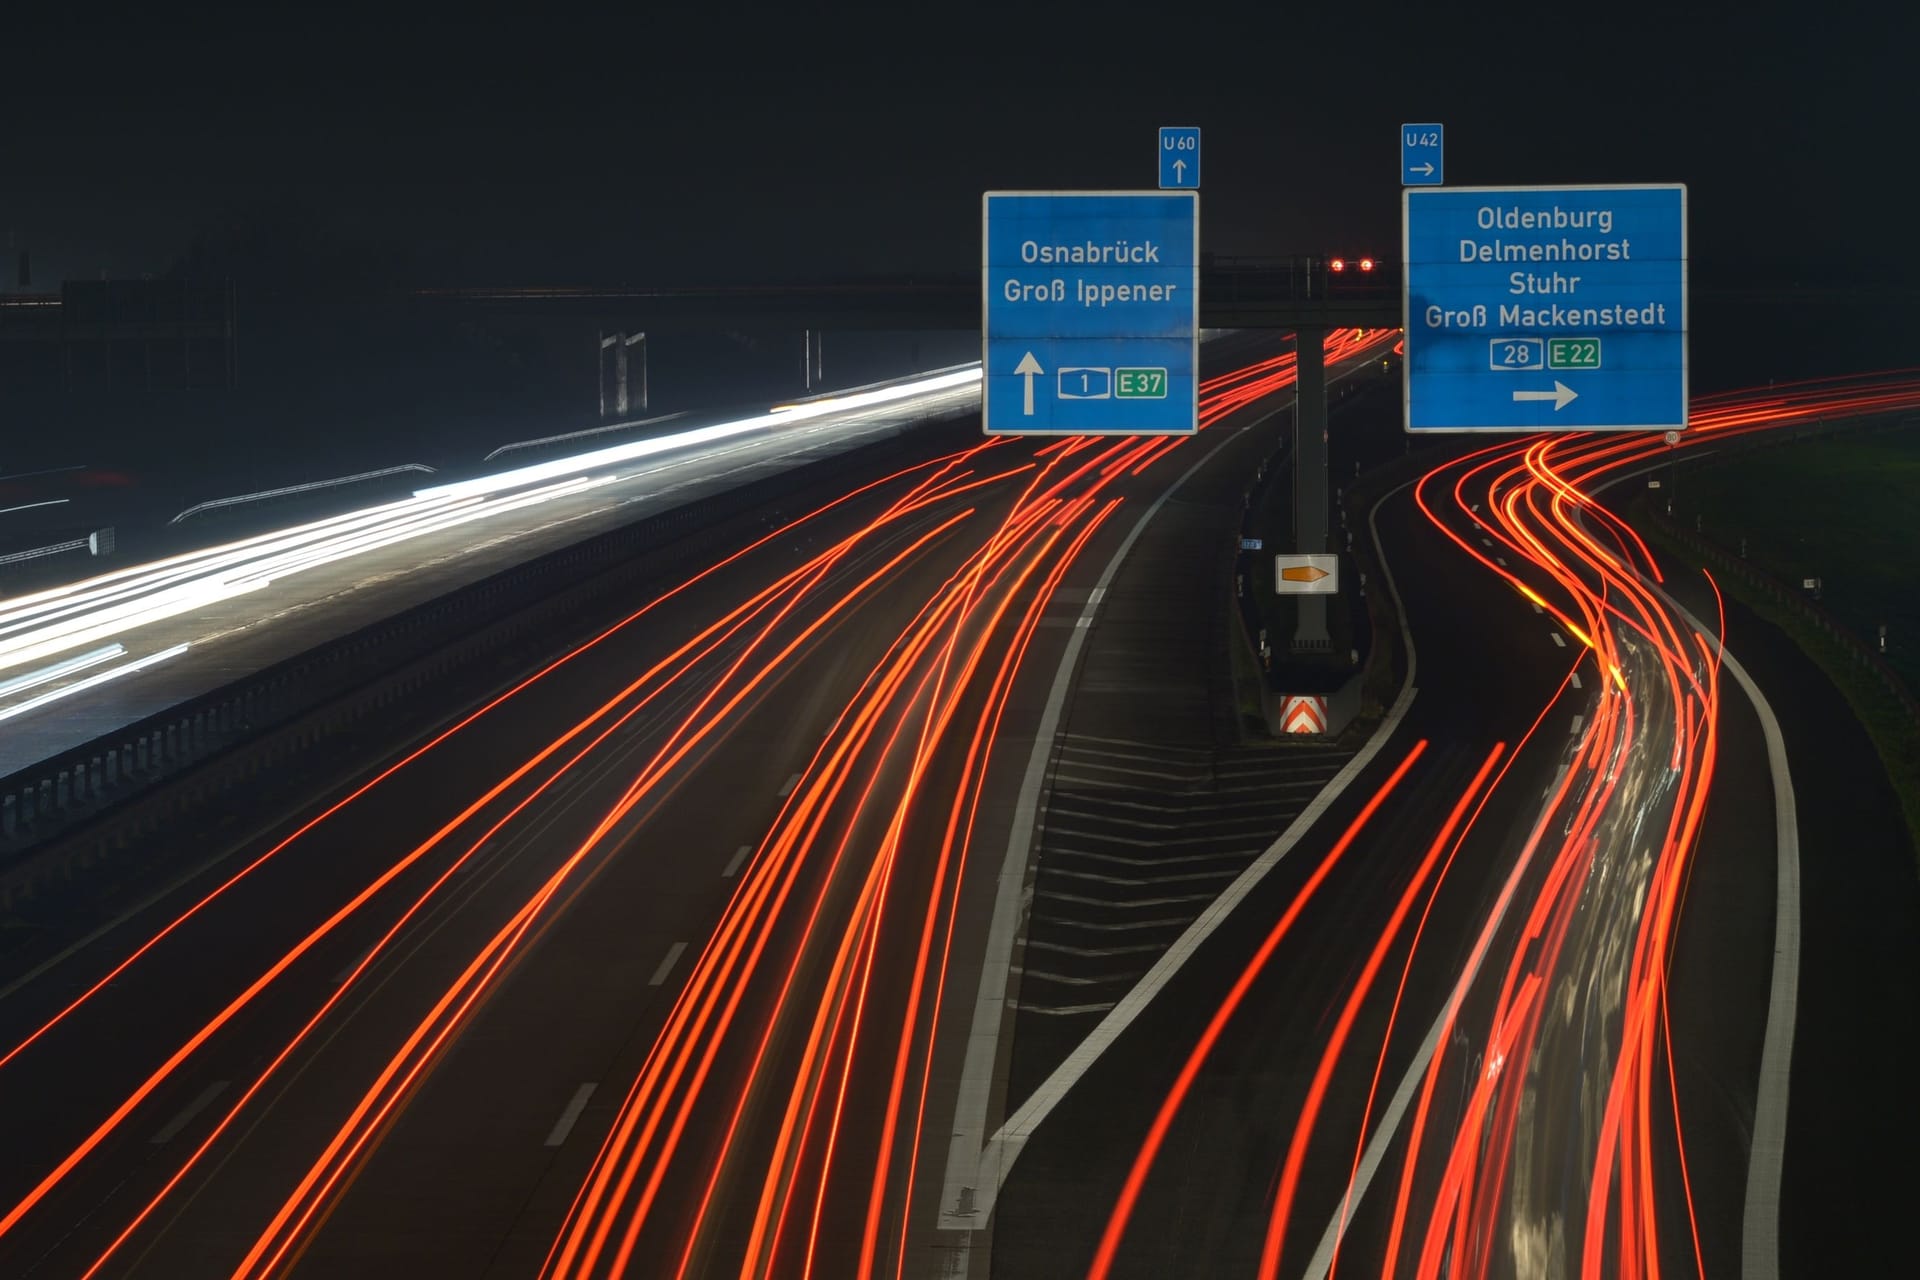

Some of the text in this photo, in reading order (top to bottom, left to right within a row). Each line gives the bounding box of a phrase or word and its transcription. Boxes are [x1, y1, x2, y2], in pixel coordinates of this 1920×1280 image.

[1477, 206, 1613, 234] Oldenburg
[1021, 240, 1160, 264] Osnabrück
[1459, 238, 1630, 263] Delmenhorst
[1004, 278, 1177, 308] Groß Ippener
[1509, 271, 1581, 295] Stuhr
[1425, 302, 1666, 328] Groß Mackenstedt
[1503, 344, 1530, 364] 28
[1080, 373, 1089, 393] 1
